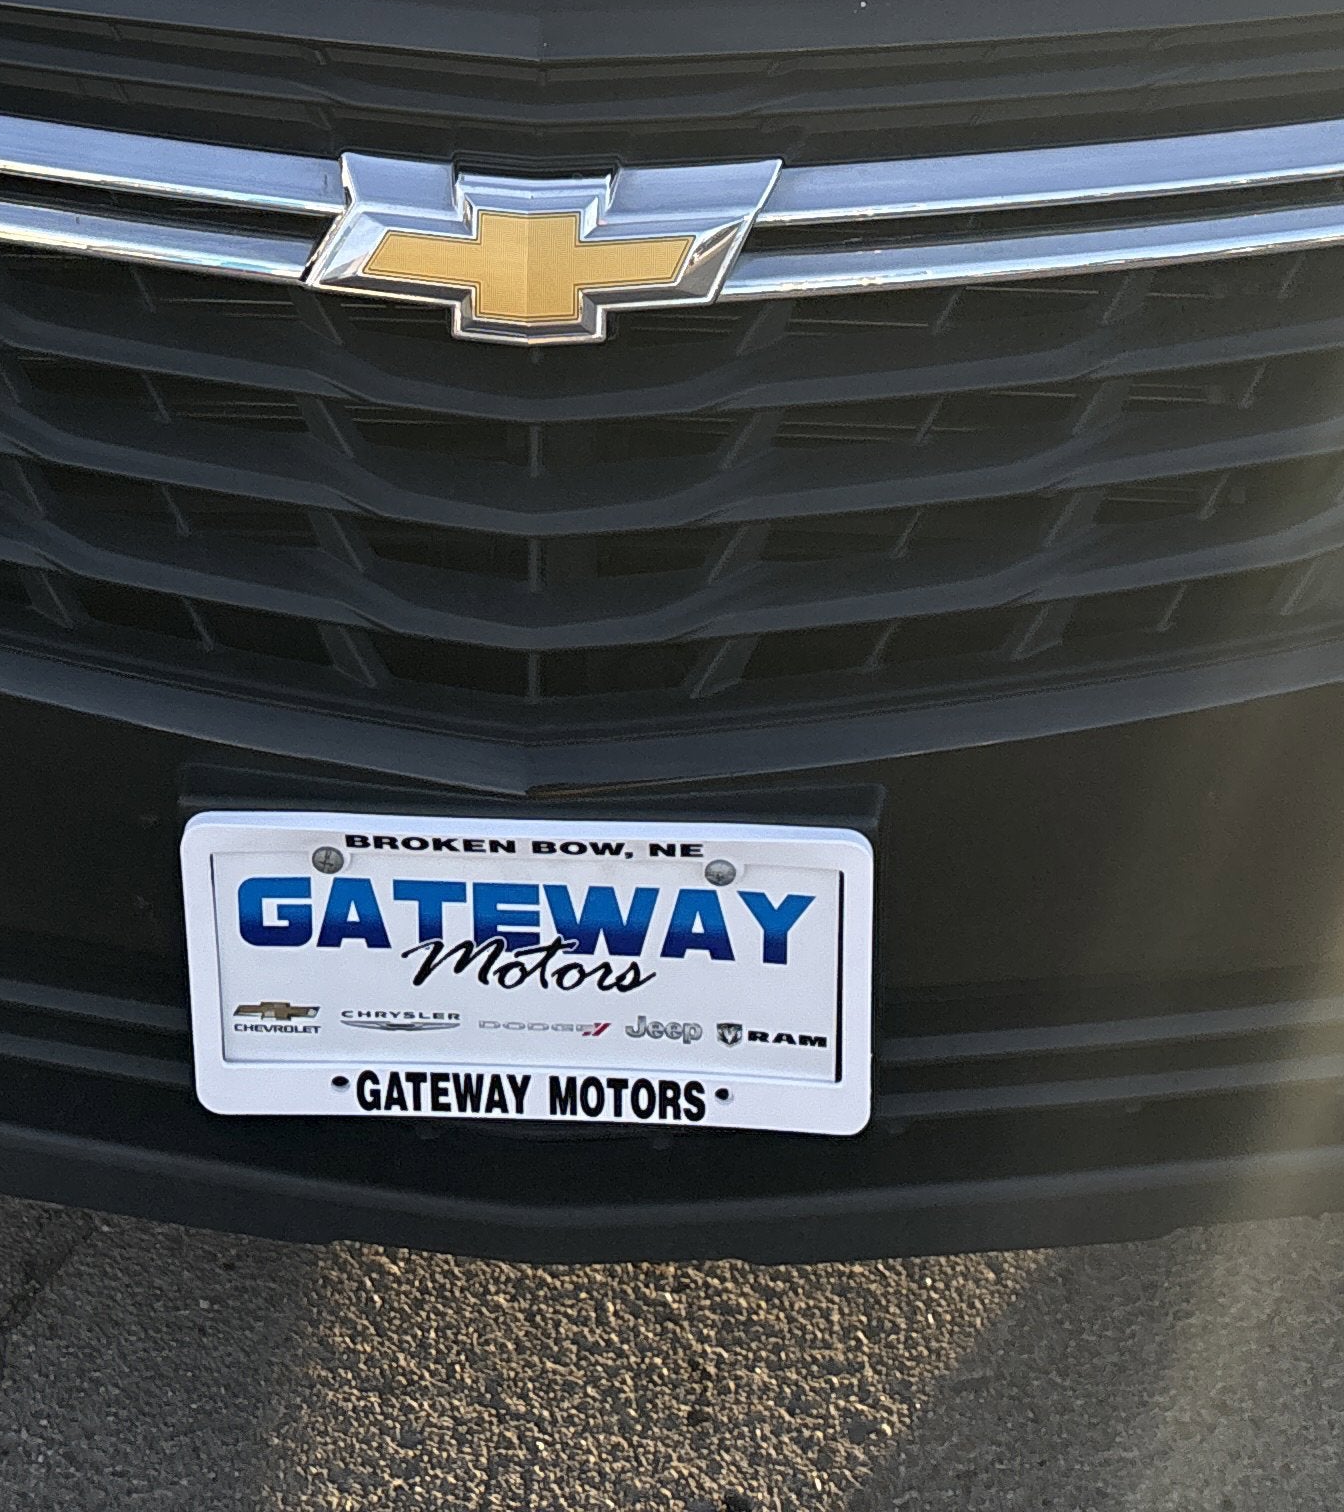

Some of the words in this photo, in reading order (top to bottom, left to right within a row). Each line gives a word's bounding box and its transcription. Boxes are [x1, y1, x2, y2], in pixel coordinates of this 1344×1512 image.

[344, 834, 516, 853] BROKEN
[531, 840, 633, 859] BOW,
[649, 842, 704, 858] NE
[238, 876, 816, 964] GATEWAY
[401, 936, 657, 993] Motors
[234, 1023, 321, 1035] CHEVROLET
[341, 1010, 461, 1020] CHRYSLER
[625, 1015, 703, 1044] Jeep
[747, 1030, 828, 1048] RAM
[356, 1070, 531, 1115] GATEWAY
[548, 1075, 706, 1122] MOTORS
